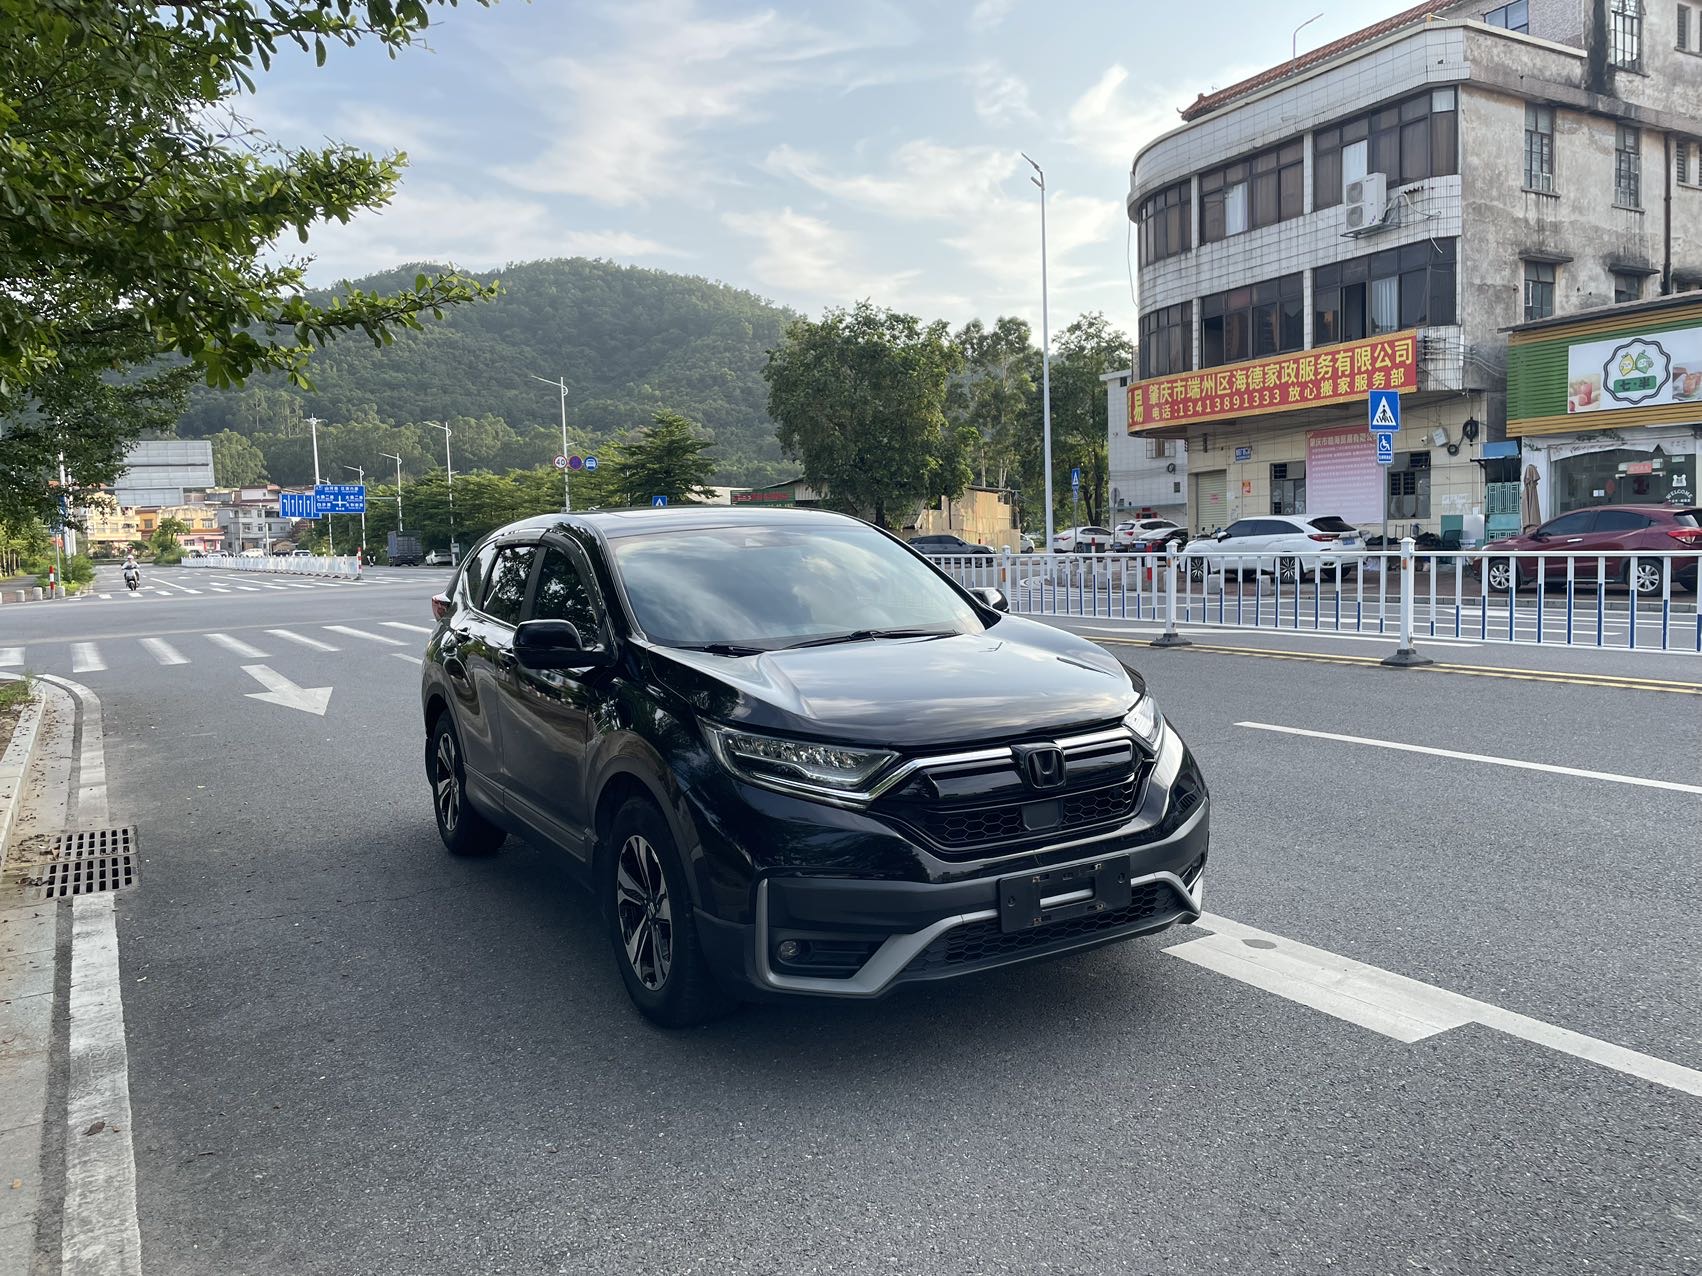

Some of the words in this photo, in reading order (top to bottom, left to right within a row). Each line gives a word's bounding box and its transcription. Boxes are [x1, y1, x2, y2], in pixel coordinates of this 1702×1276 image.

[1148, 338, 1413, 405] 肇庆市端州区海德家政服务有限公司
[1288, 368, 1405, 402] 放心搬家服务部
[555, 458, 566, 466] 40
[1665, 489, 1694, 499] WELCOME
